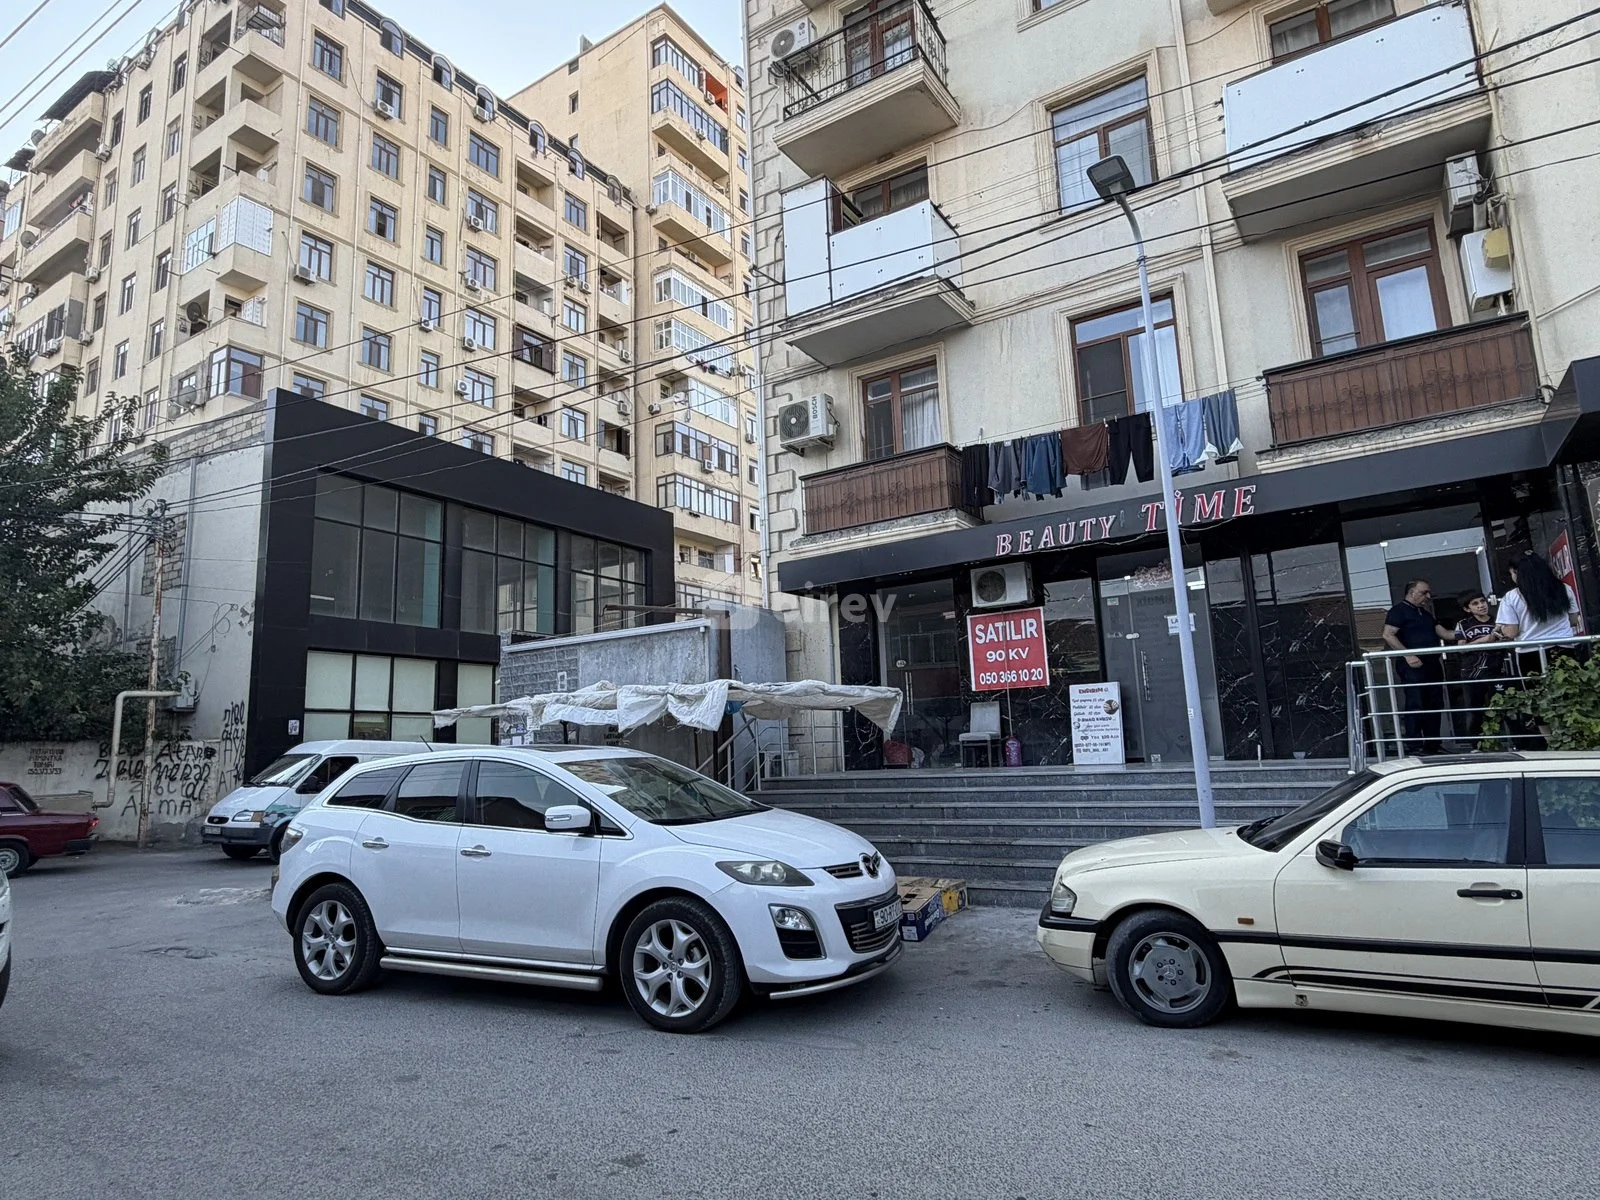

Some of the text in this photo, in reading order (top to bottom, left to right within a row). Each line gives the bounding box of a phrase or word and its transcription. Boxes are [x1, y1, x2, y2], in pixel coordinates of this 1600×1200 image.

[811, 396, 819, 420] BOSCH
[995, 514, 1117, 557] BEAUTY
[975, 618, 1039, 645] SATILIR
[986, 647, 1030, 663] 90 KV
[979, 668, 1044, 685] 050 366 10 20
